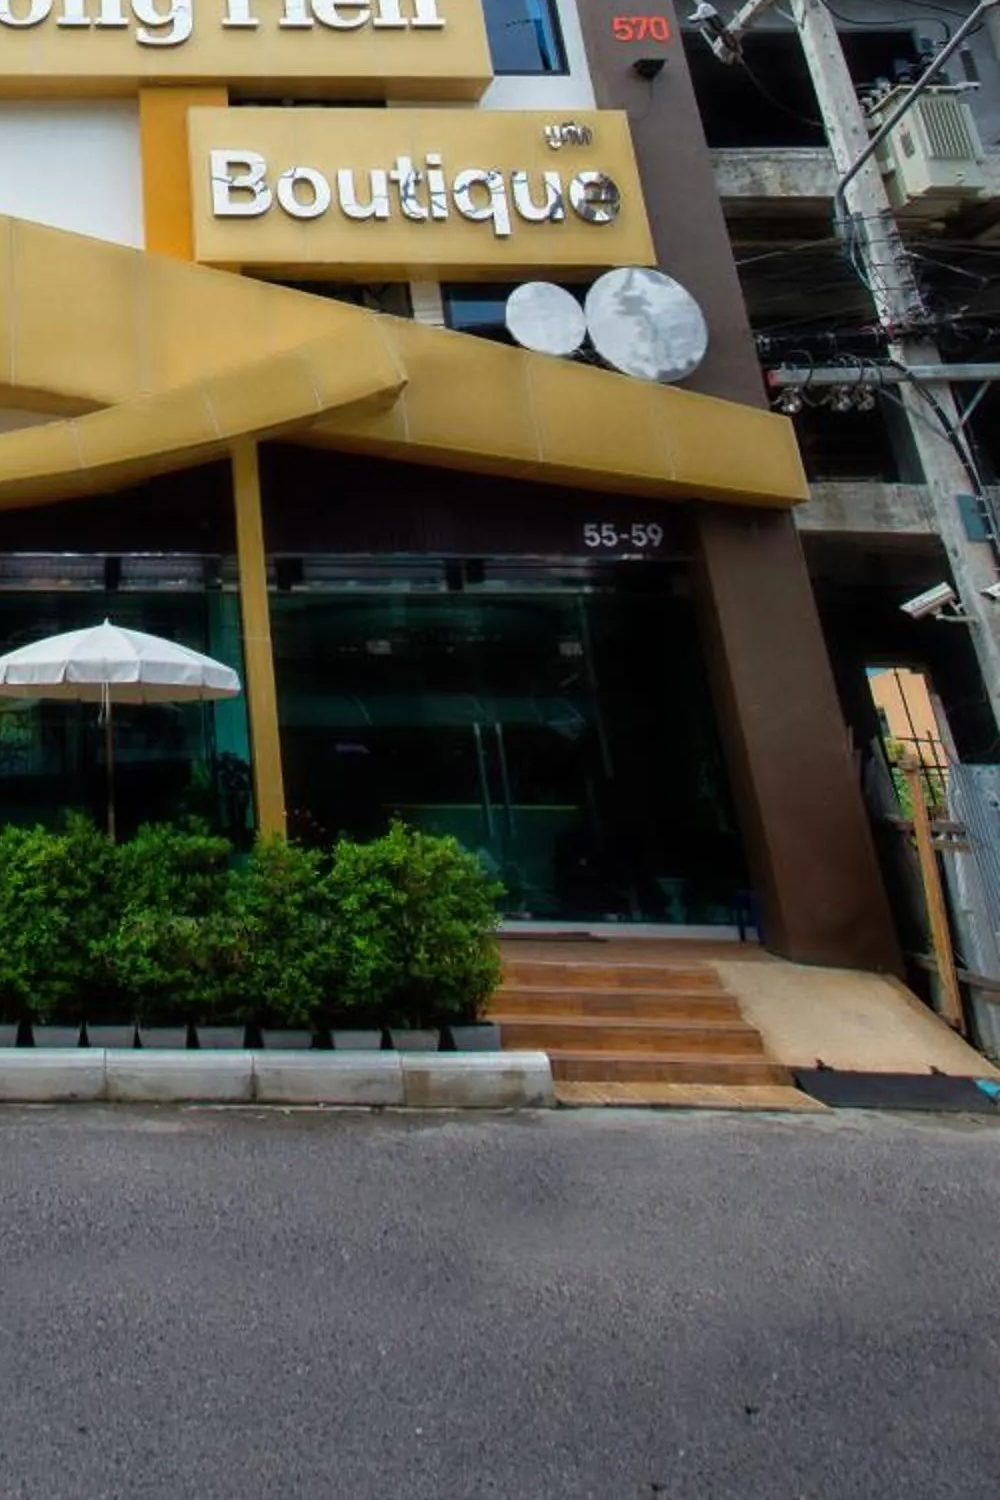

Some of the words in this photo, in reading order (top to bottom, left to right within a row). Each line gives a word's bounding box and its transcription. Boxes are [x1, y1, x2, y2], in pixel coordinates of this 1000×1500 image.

[612, 15, 671, 43] 570
[210, 148, 623, 237] Boutique
[583, 523, 664, 547] 55-59
